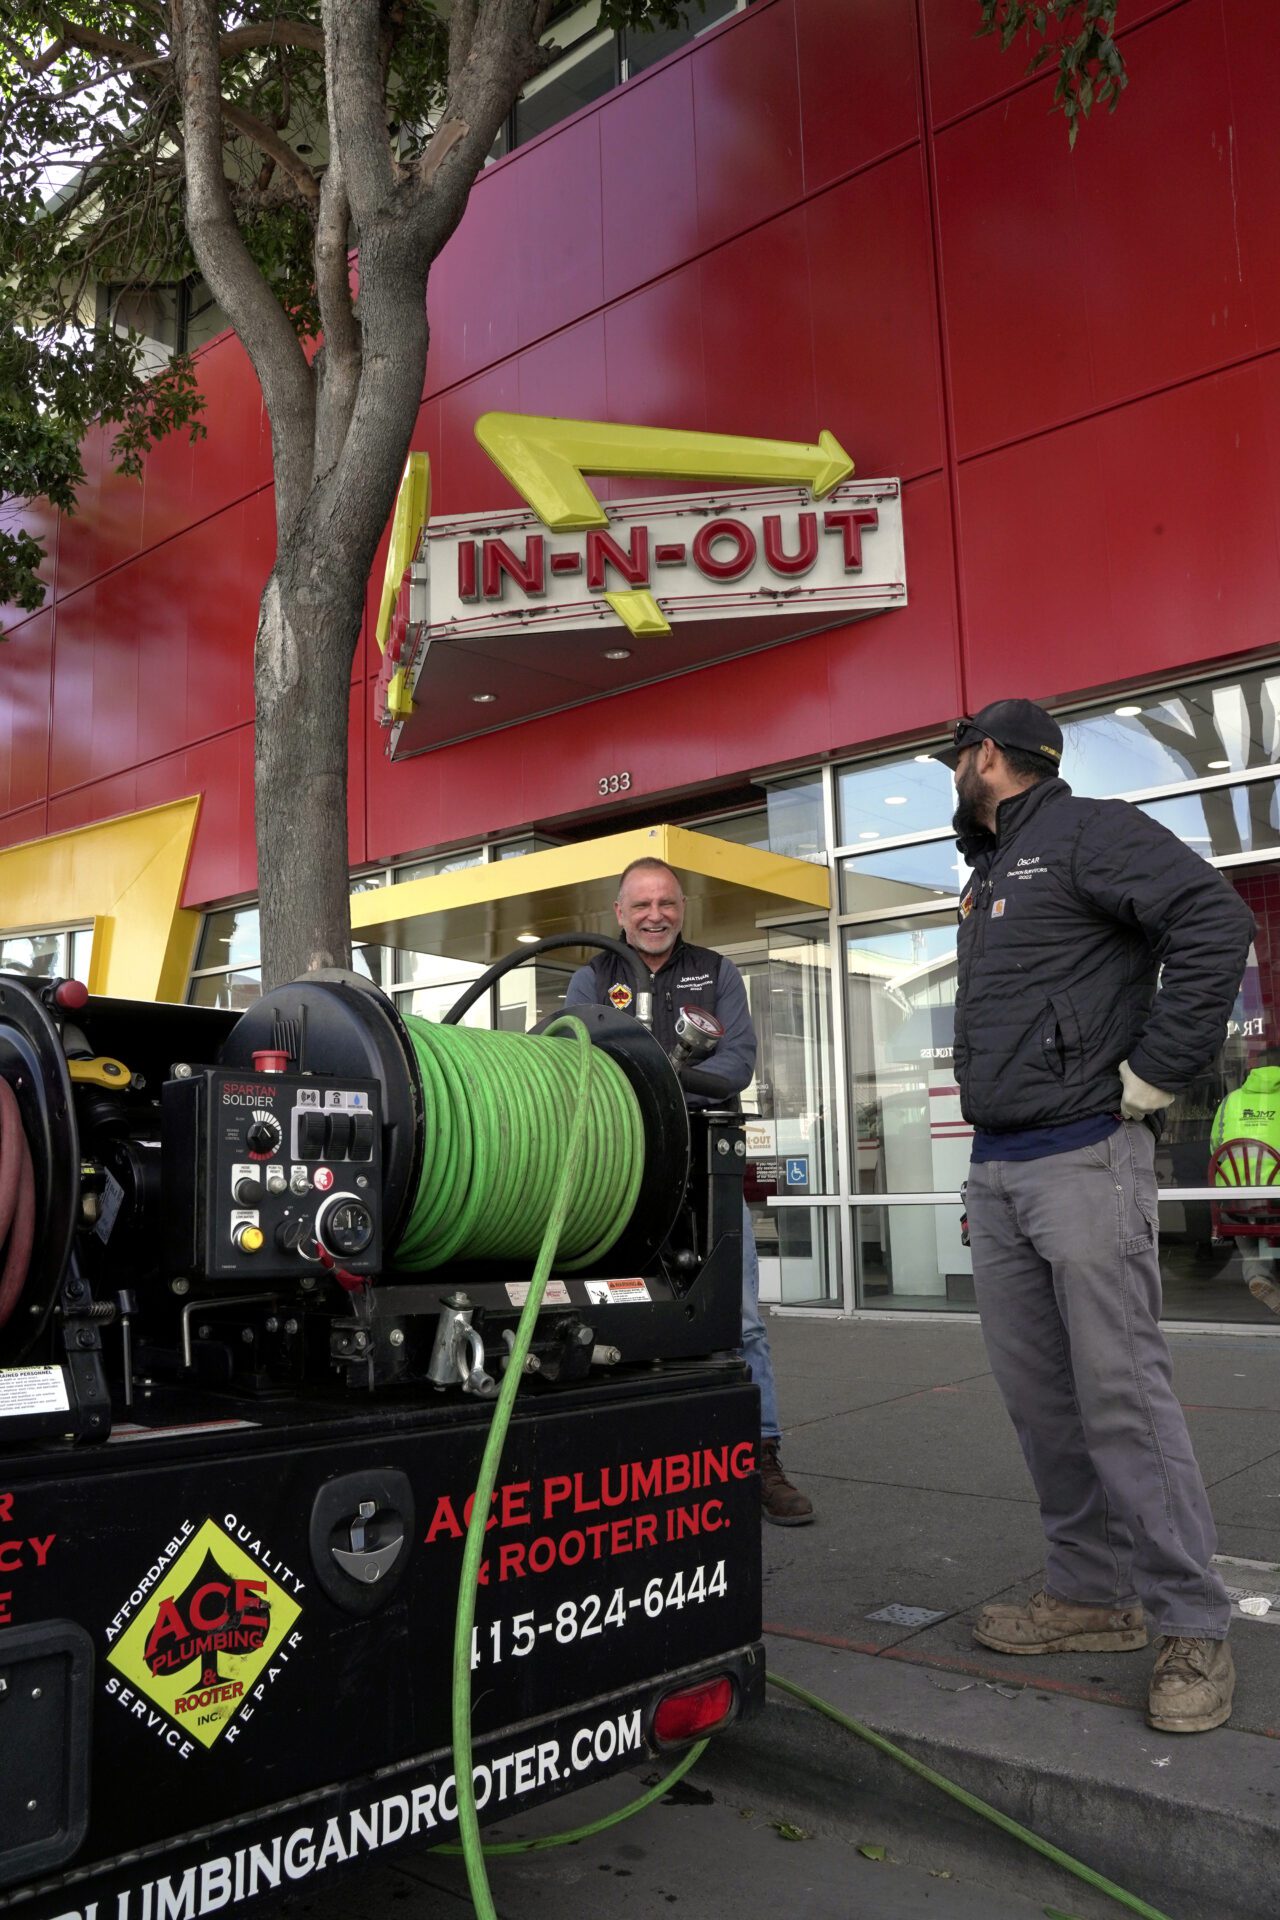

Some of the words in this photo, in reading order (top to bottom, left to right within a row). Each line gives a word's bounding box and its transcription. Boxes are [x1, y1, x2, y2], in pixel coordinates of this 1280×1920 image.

[458, 507, 879, 604] IN-N-OUT
[598, 771, 631, 796] 333
[1017, 857, 1040, 867] OSCAR
[680, 975, 709, 983] JONATHAN
[222, 1094, 274, 1107] SOLDIER
[223, 1083, 276, 1097] SPARTAN
[424, 1480, 531, 1544] ACE
[542, 1441, 755, 1520] PLUMBING
[224, 1513, 305, 1594] QUALITY
[498, 1513, 658, 1582] ROOTER
[665, 1499, 731, 1542] INC.
[104, 1519, 195, 1642] AFFORDABLE
[143, 1578, 268, 1661] ACE
[151, 1630, 264, 1678] PLUMBING
[202, 1668, 217, 1686] &
[105, 1677, 195, 1759] SERVICE
[174, 1681, 244, 1715] ROOTER
[197, 1712, 222, 1726] INC.
[225, 1631, 303, 1743] REPAIR
[48, 1709, 643, 1920] UMBINGANDROOTER.COM
